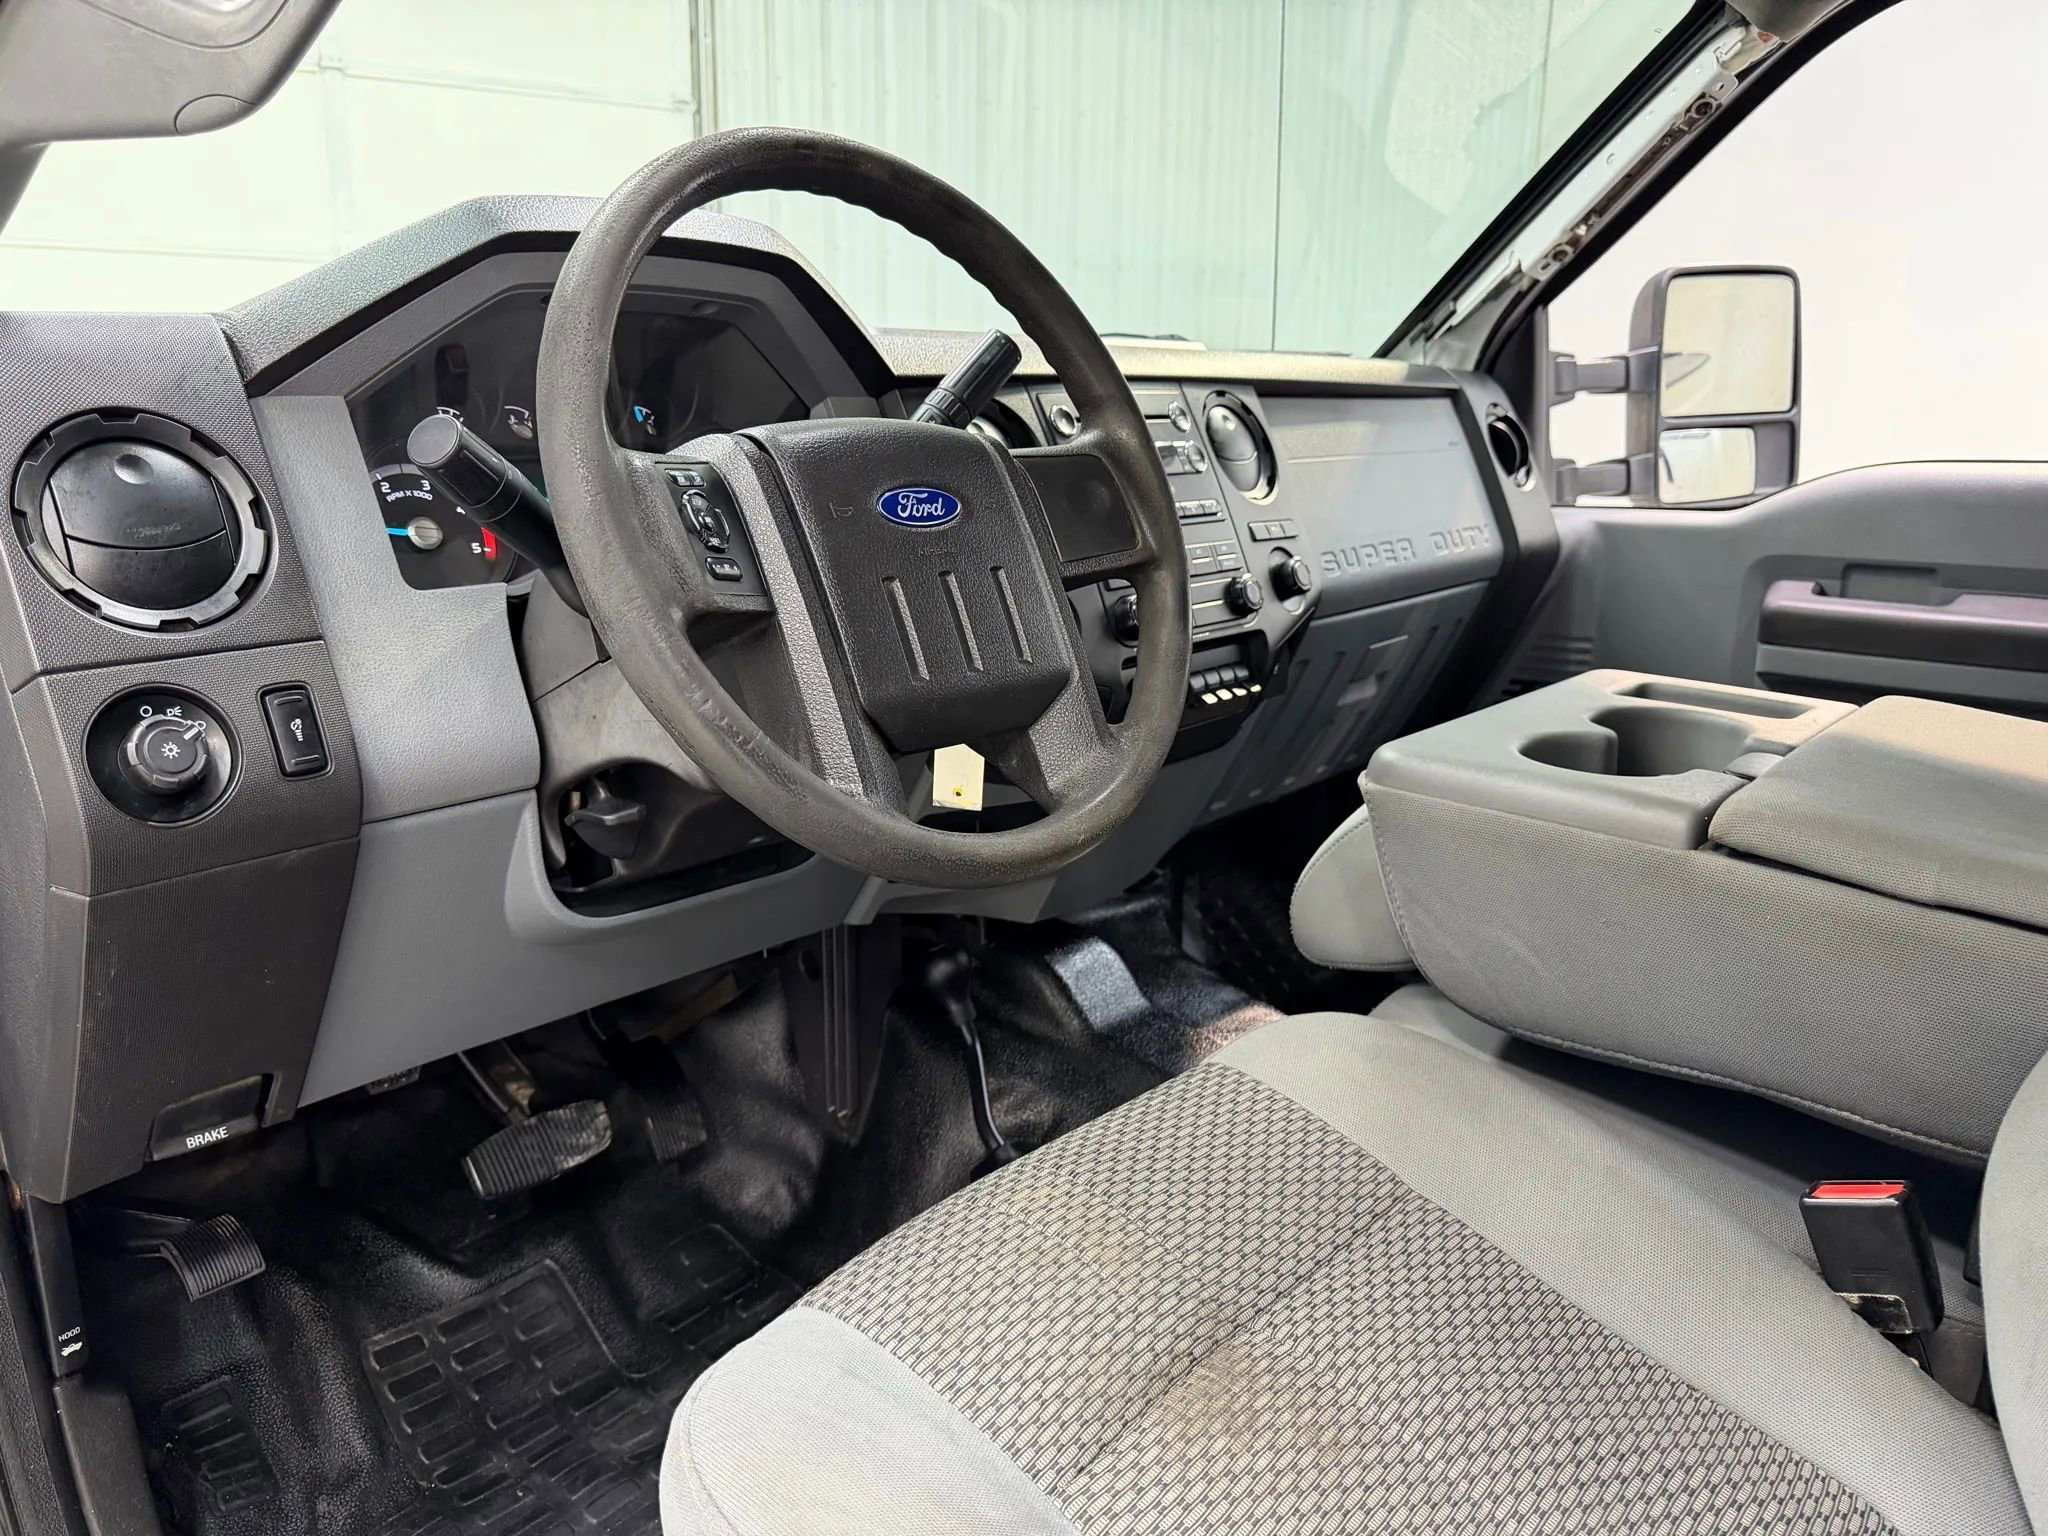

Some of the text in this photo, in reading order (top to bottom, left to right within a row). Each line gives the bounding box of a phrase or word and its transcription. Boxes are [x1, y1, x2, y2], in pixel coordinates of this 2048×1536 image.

[380, 482, 391, 493] 2
[420, 480, 431, 491] 3
[386, 490, 404, 502] RPM
[412, 490, 433, 501] 1000
[897, 492, 945, 518] Ford
[471, 542, 482, 554] 5
[1320, 523, 1490, 578] SUPER DUTY
[185, 1126, 229, 1149] BRAKE
[58, 1326, 81, 1342] HOOD
